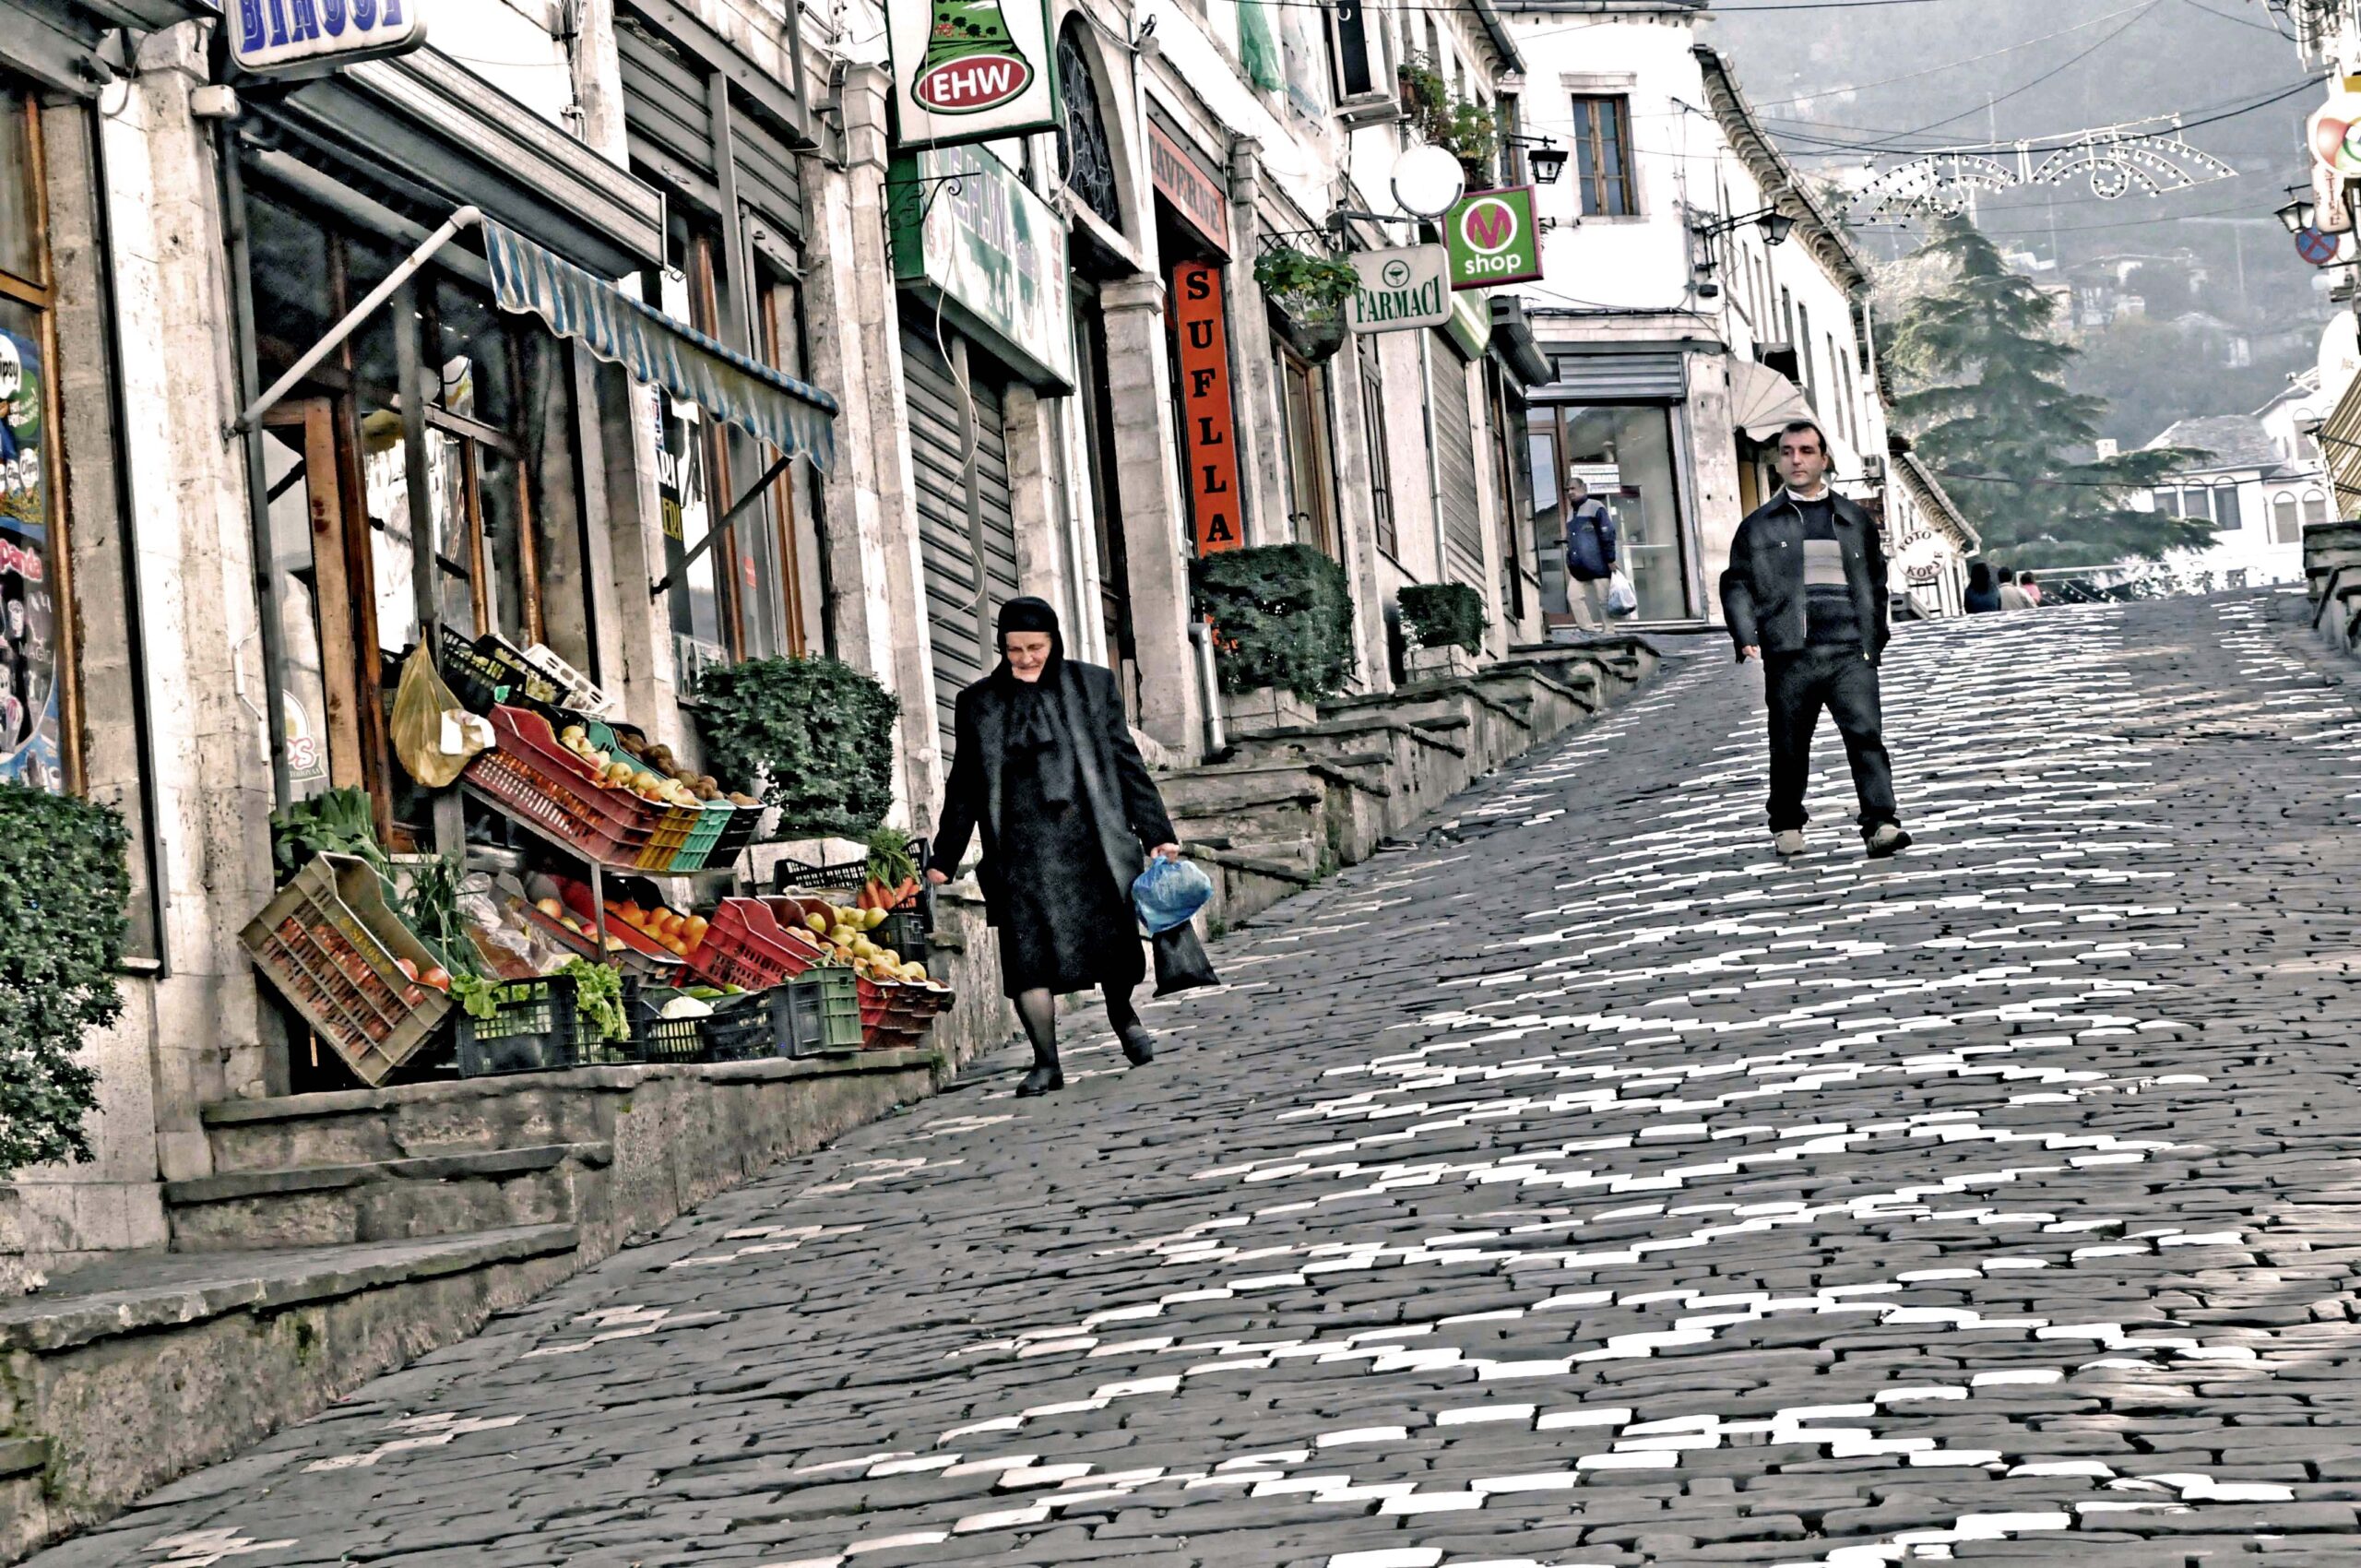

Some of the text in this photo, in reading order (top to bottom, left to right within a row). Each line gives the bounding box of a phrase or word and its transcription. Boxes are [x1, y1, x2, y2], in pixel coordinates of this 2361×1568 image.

[932, 63, 1011, 102] EHW
[1465, 253, 1522, 275] shop
[1356, 274, 1442, 324] FARMACI
[1898, 530, 1932, 552] FOTO
[1905, 551, 1943, 577] KOPJE
